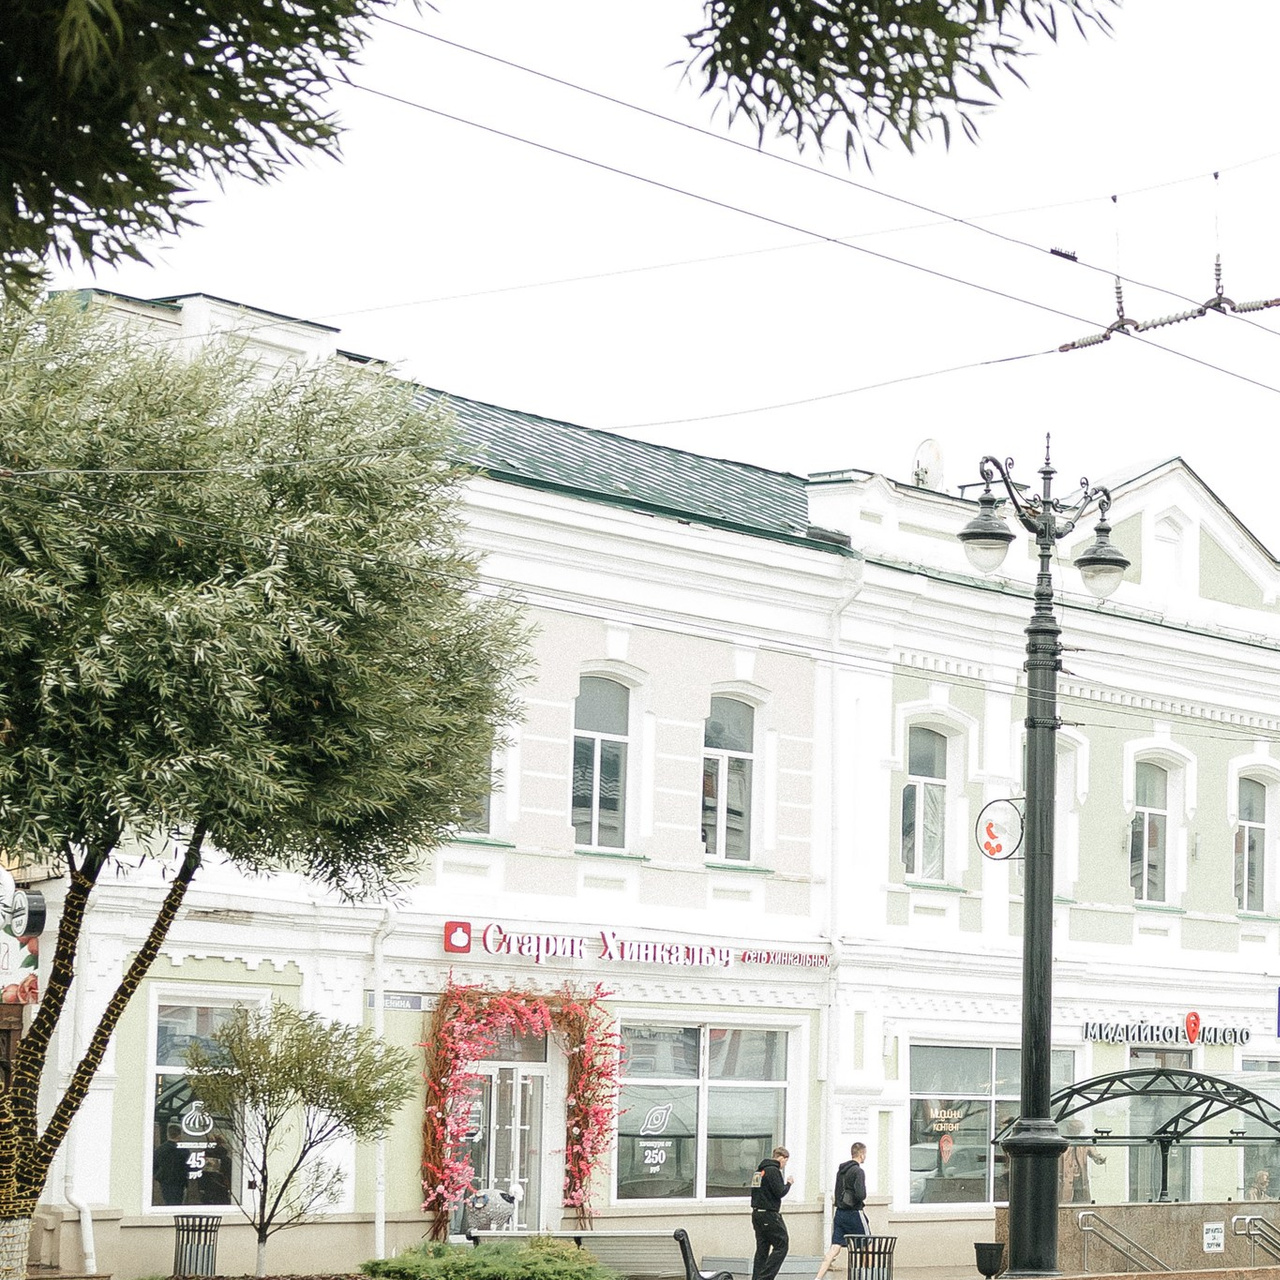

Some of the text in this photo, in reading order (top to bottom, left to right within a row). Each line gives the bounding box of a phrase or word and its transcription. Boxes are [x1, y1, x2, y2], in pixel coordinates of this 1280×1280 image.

[482, 923, 735, 967] Старик Хинкалыч
[741, 951, 769, 964] сеть
[384, 999, 412, 1009] ЕНИНА
[1201, 1026, 1251, 1046] МЕСТО
[186, 1151, 206, 1169] 45
[644, 1149, 666, 1164] 250
